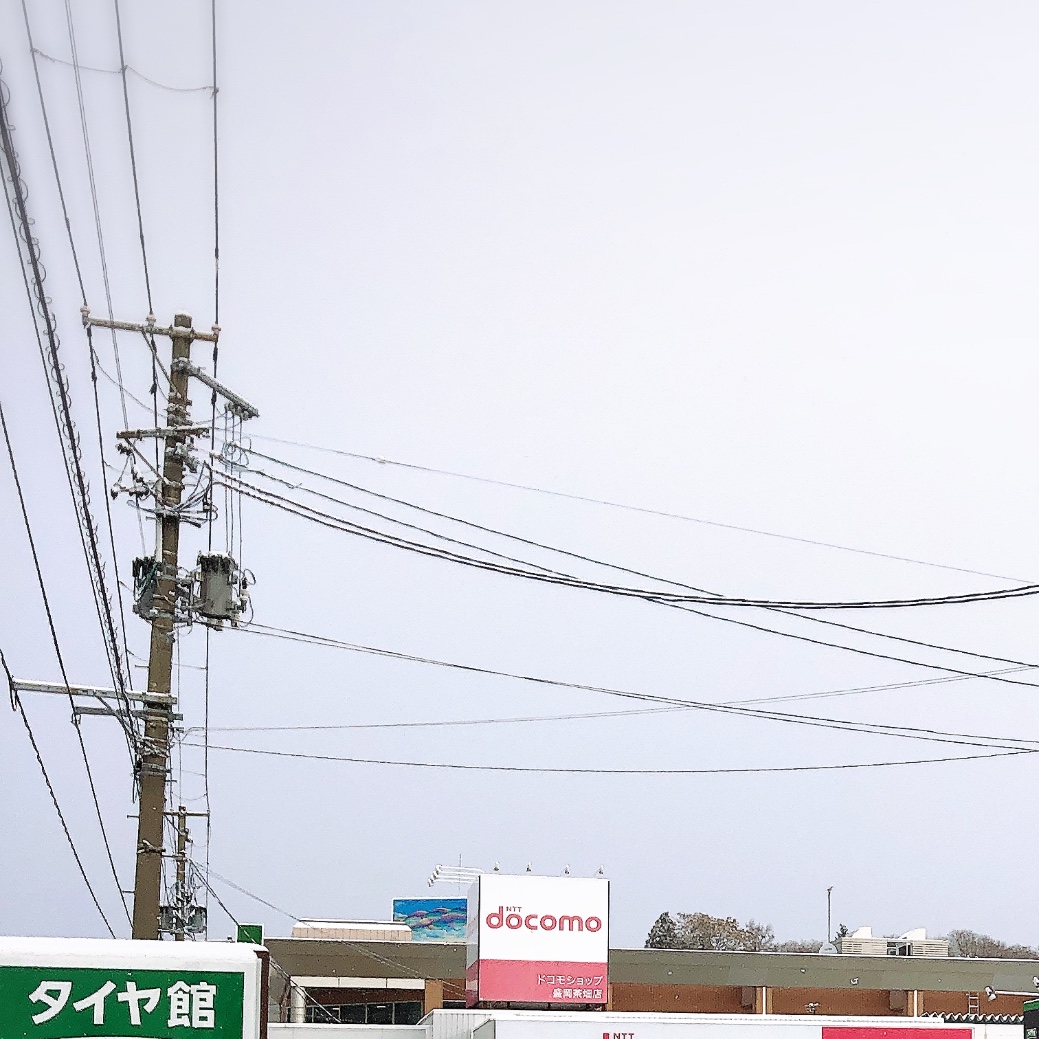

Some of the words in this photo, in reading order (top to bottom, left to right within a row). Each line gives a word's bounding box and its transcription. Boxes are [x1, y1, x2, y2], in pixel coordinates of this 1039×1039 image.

[486, 906, 602, 932] docomo
[537, 974, 603, 986] ドコモショップ
[28, 980, 217, 1028] タイヤ館
[552, 989, 603, 1000] 盛岡茶畑店
